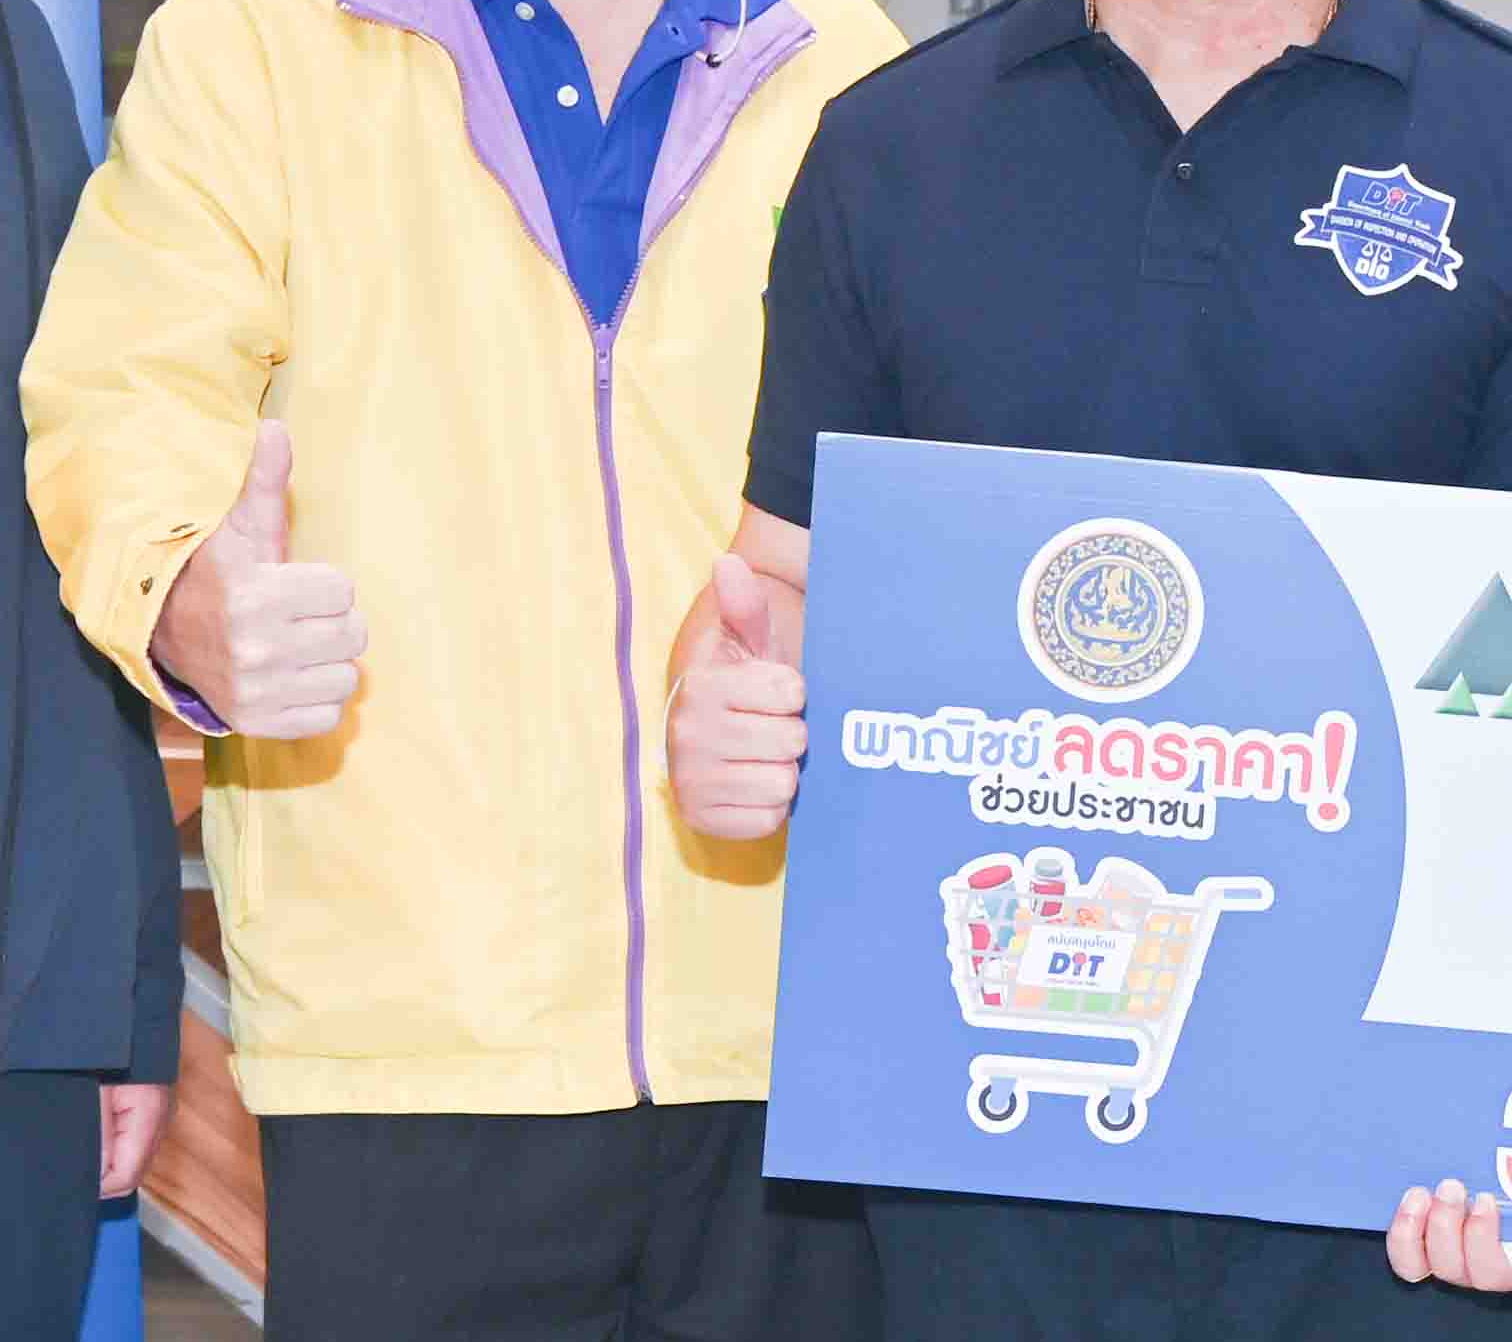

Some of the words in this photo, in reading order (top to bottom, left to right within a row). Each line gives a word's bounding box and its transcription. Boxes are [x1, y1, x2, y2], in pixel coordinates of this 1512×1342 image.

[853, 718, 1042, 768] พาณิชย์
[1054, 721, 1346, 820] ลดราคา!
[981, 773, 1205, 830] ช่วยประชาชน
